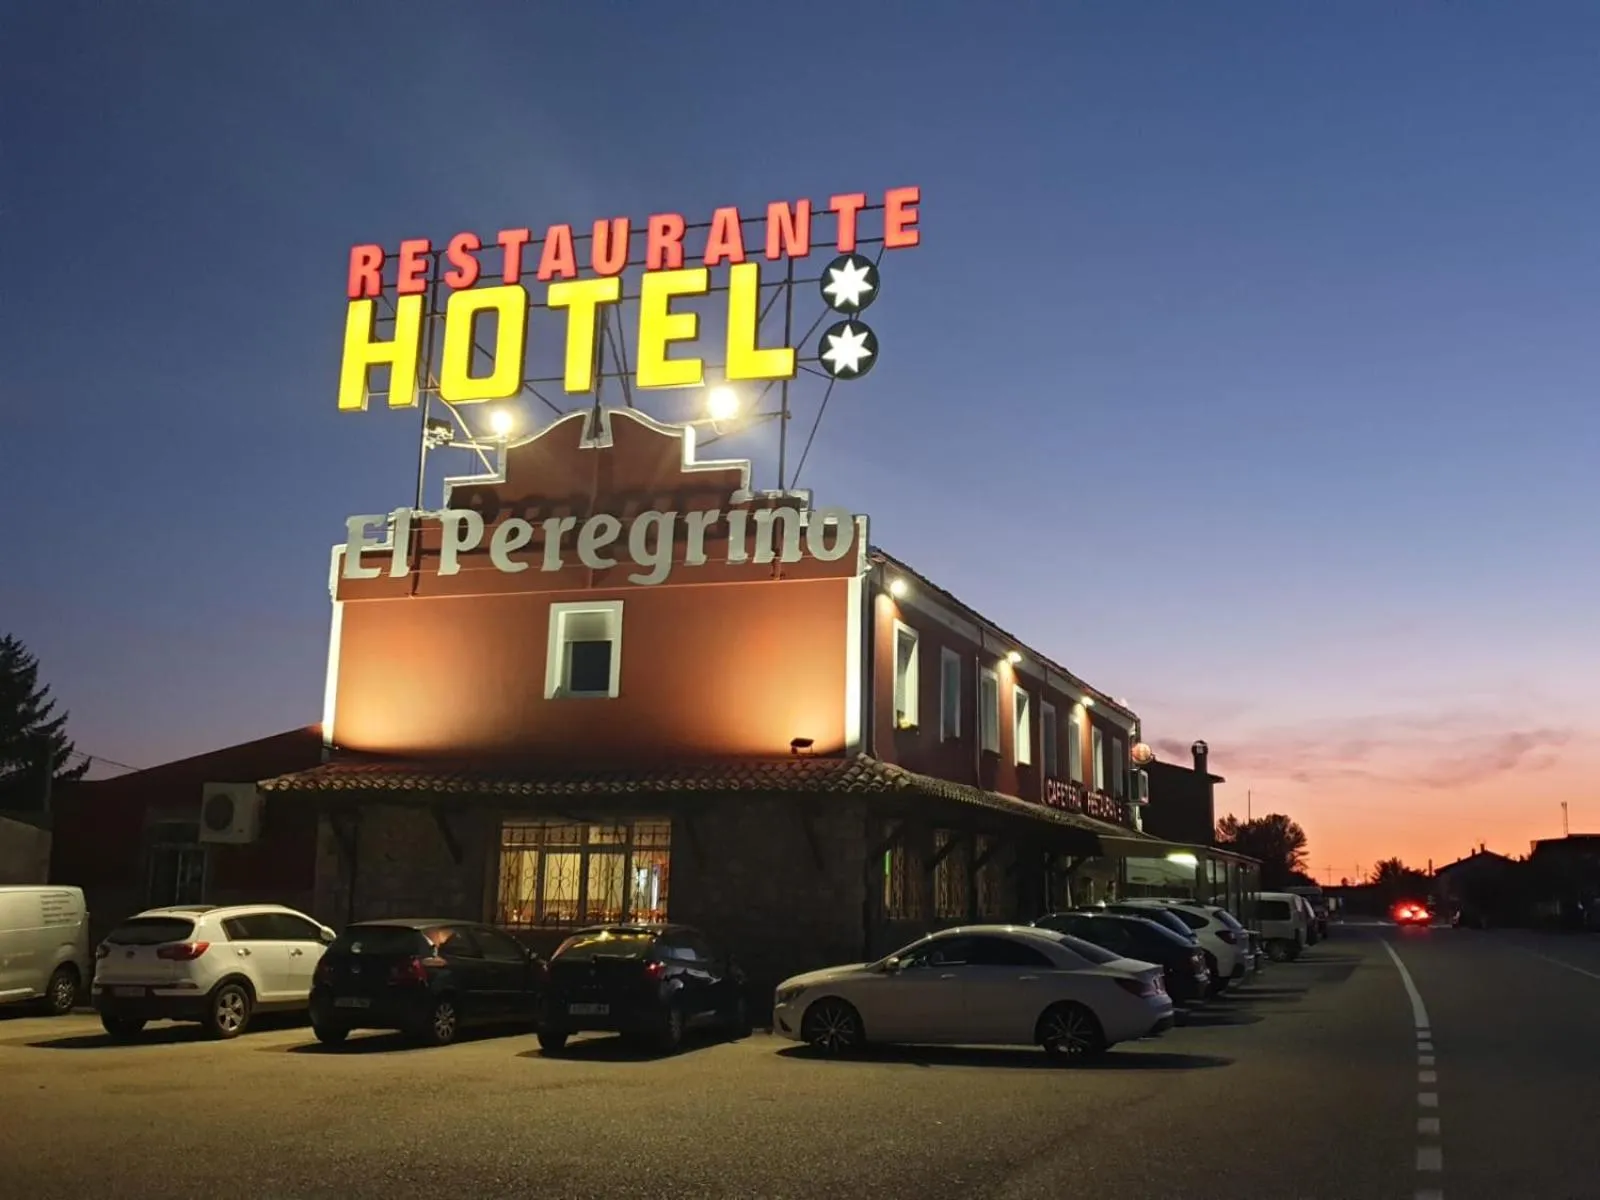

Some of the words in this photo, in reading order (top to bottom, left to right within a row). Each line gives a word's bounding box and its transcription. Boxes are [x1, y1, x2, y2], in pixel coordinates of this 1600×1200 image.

[347, 186, 920, 298] RESTAURANTE
[338, 262, 796, 411] HOTEL
[342, 508, 413, 579] El
[438, 505, 855, 586] Peregrino
